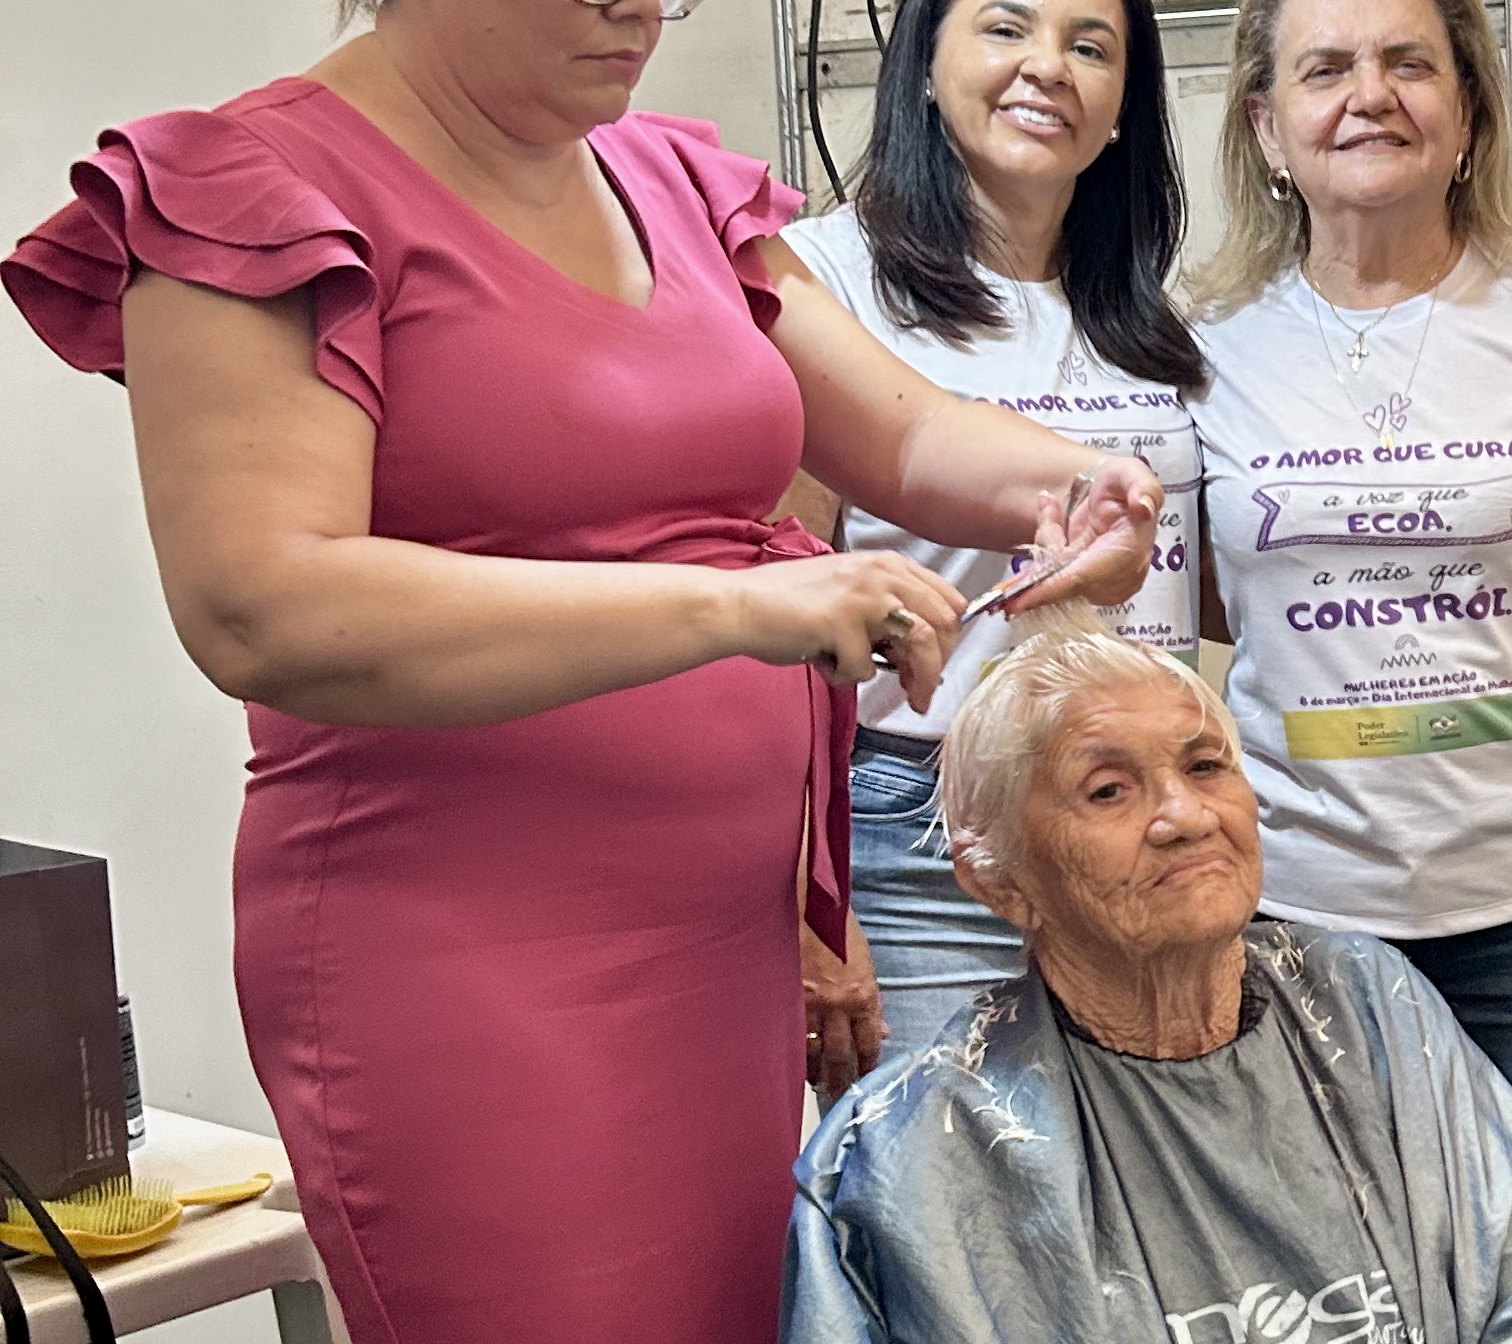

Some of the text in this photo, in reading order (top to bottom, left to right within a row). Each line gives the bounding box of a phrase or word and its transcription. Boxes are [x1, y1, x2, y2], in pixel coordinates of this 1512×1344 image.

[1074, 394, 1127, 412] QUE
[1129, 392, 1180, 408] CUR
[1130, 434, 1167, 457] que
[1276, 448, 1364, 469] AMOR
[1373, 443, 1435, 463] QUE
[1323, 488, 1469, 512] a voz que
[1158, 513, 1182, 527] ue
[1348, 510, 1452, 533] ECOA.
[1313, 562, 1486, 591] a mão que
[1286, 584, 1512, 632] CONSTRÓI.
[1116, 622, 1172, 637] EM AÇÃO
[1343, 670, 1477, 692] MULHERES EM AÇÃO
[1311, 697, 1324, 706] de
[1372, 692, 1393, 702] Dia
